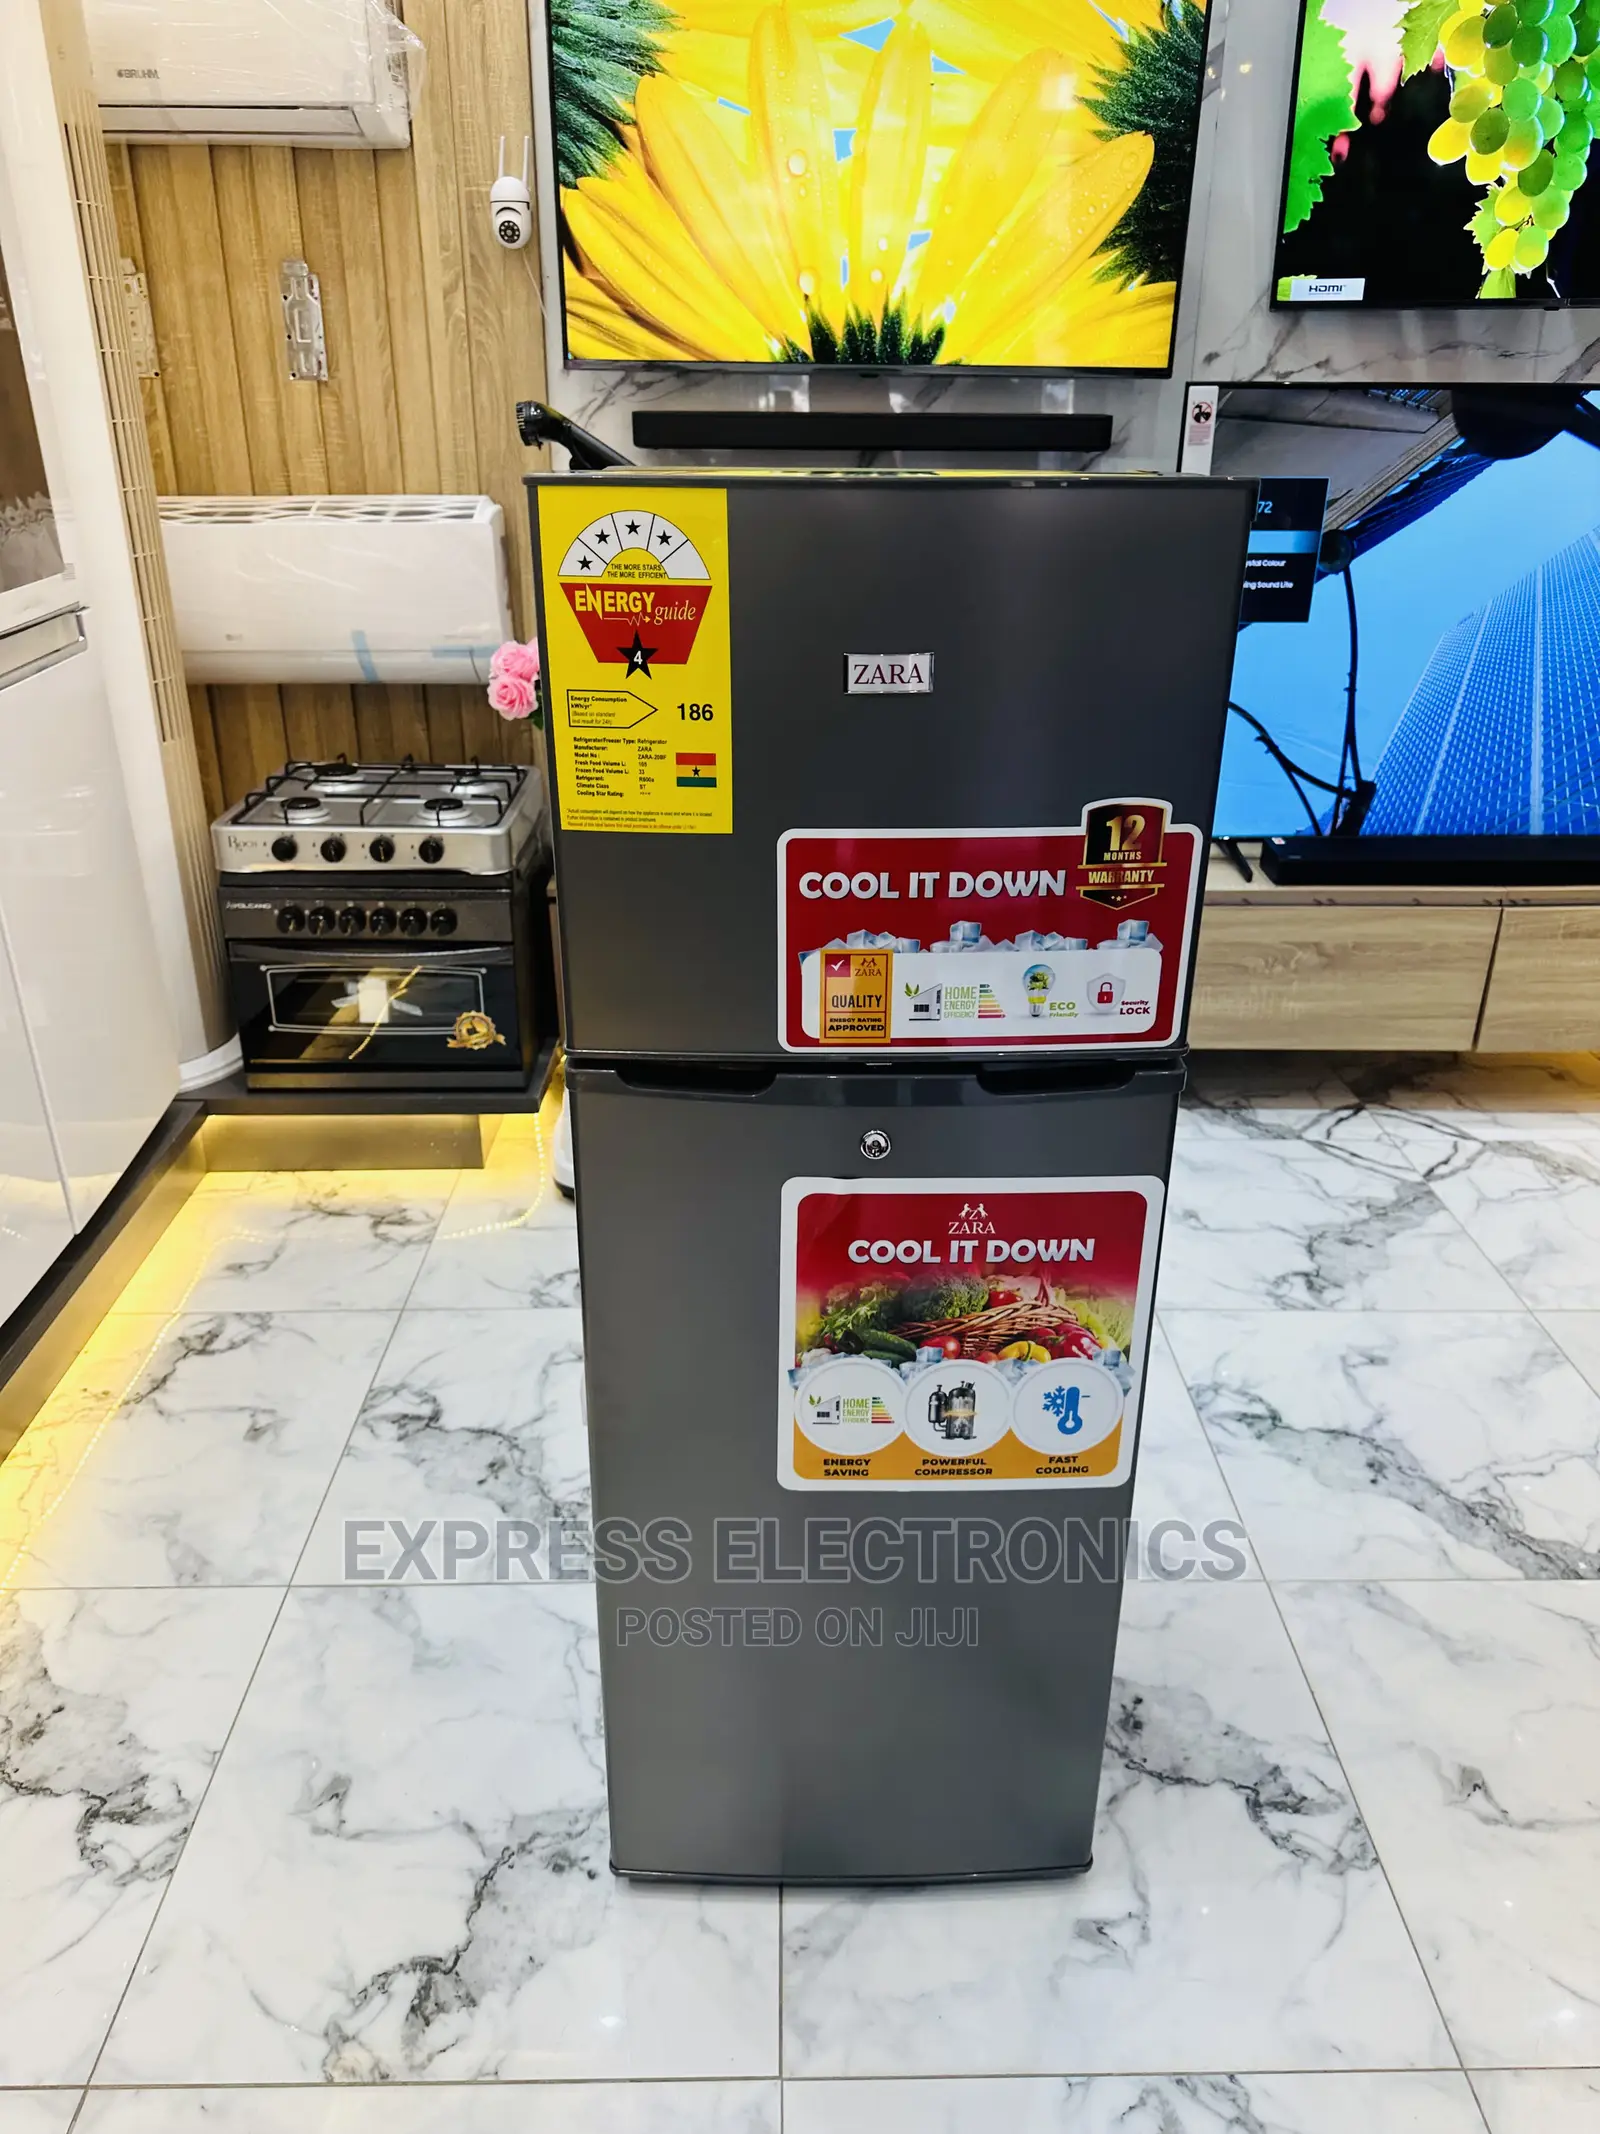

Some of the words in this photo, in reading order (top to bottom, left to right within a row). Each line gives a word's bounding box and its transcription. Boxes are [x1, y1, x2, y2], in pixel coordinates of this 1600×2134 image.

[574, 584, 655, 620] ENERGY
[654, 600, 696, 626] guide
[633, 650, 643, 665] 4
[853, 663, 924, 684] ZARA
[677, 703, 714, 721] 186
[1106, 814, 1146, 851] 12
[1104, 851, 1142, 861] MONTHS
[1088, 870, 1154, 884] WARRANTY
[798, 871, 900, 899] COOL
[908, 871, 940, 898] IT
[948, 869, 1066, 898] DOWN
[854, 968, 882, 977] ZARA
[944, 986, 978, 1000] HOME
[831, 994, 882, 1008] QUALITY
[944, 1000, 976, 1010] ENERGY
[1049, 1002, 1076, 1010] ECO
[1120, 1006, 1151, 1015] LOCK
[948, 1222, 996, 1235] ZARA
[848, 1239, 941, 1264] COOL
[949, 1239, 978, 1264] IT
[986, 1238, 1096, 1264] DOWN
[842, 1398, 870, 1409] HOME
[842, 1409, 870, 1417] ENERGY
[914, 1468, 992, 1476] COMPRESSOR
[1036, 1466, 1089, 1474] COOLING
